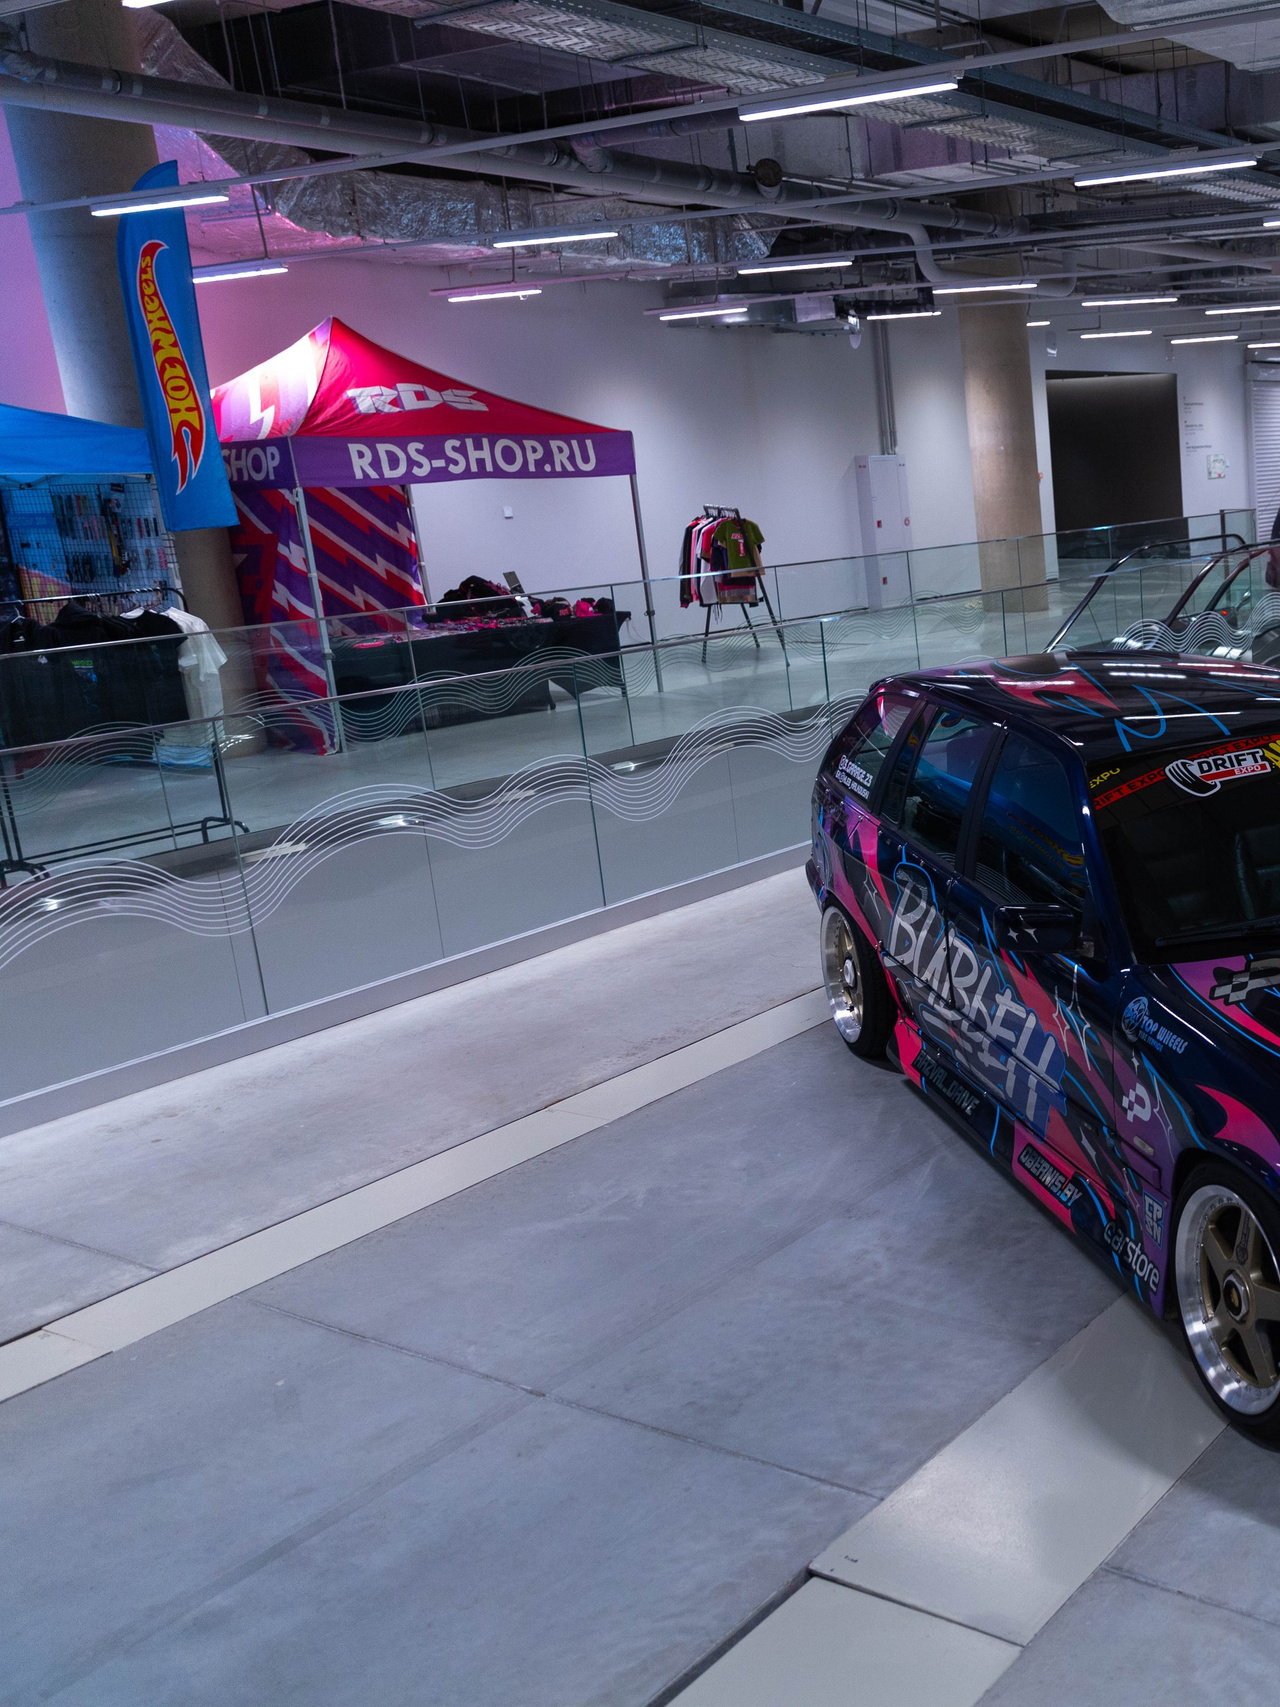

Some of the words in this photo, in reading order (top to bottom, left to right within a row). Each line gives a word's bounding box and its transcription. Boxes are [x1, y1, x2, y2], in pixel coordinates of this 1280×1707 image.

[160, 357, 201, 432] HOT
[346, 383, 489, 415] RDS
[348, 438, 596, 479] RDS-SHOP.RU
[1197, 751, 1263, 775] DRIFT
[1233, 764, 1262, 776] EXPO
[1140, 1014, 1159, 1035] TOP
[1156, 1026, 1189, 1054] WHEELS
[913, 1050, 981, 1116] RAZVAL_DRIVE
[1018, 1146, 1083, 1207] OBERNIS.BY
[1103, 1221, 1160, 1293] carstore
